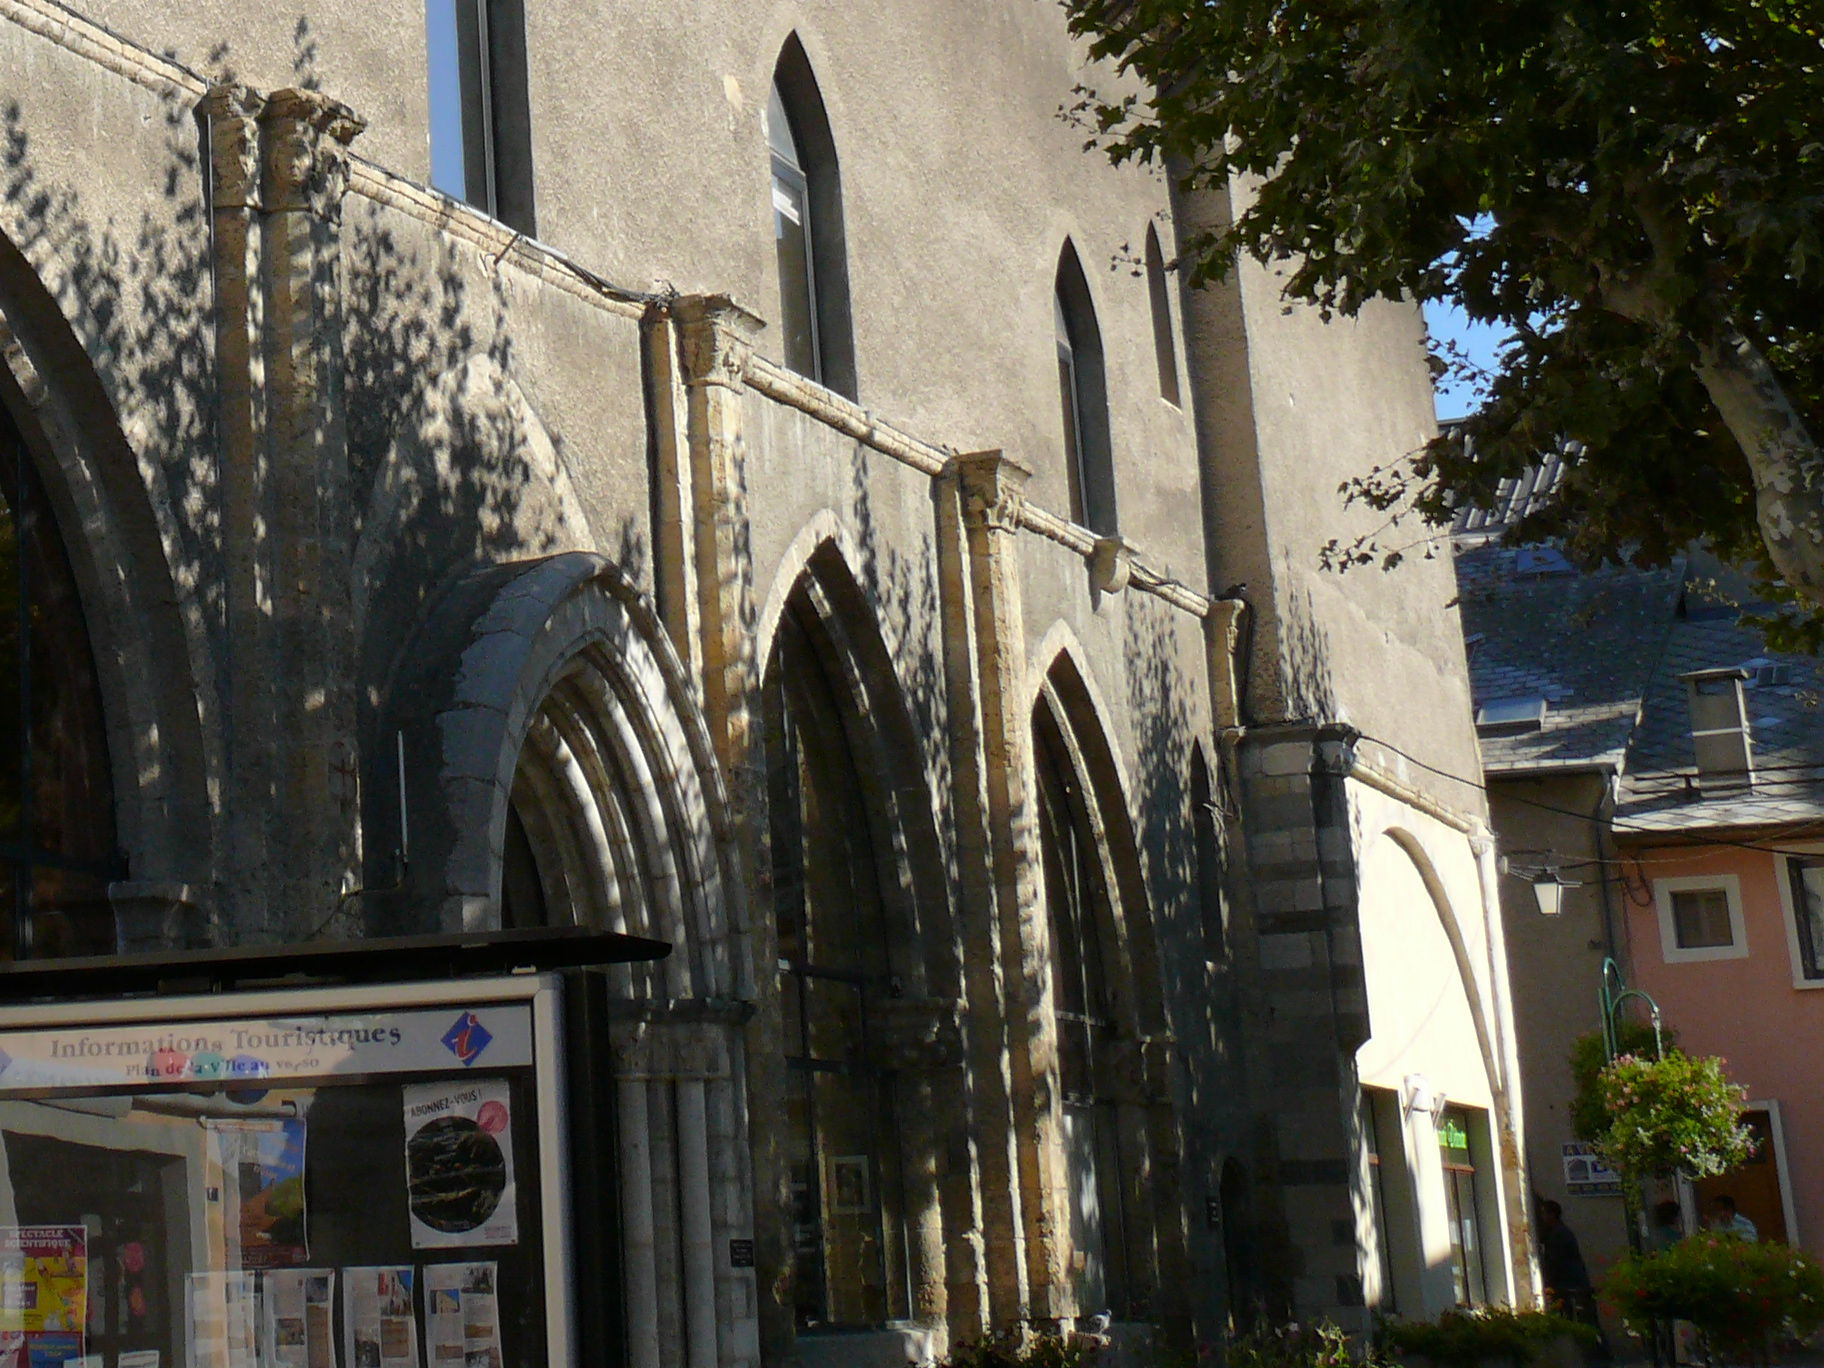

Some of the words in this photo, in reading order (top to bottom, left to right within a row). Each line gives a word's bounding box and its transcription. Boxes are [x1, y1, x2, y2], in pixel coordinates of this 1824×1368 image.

[50, 1033, 223, 1058] Informations
[230, 1025, 402, 1051] Touristiques
[211, 1060, 245, 1072] Vlle
